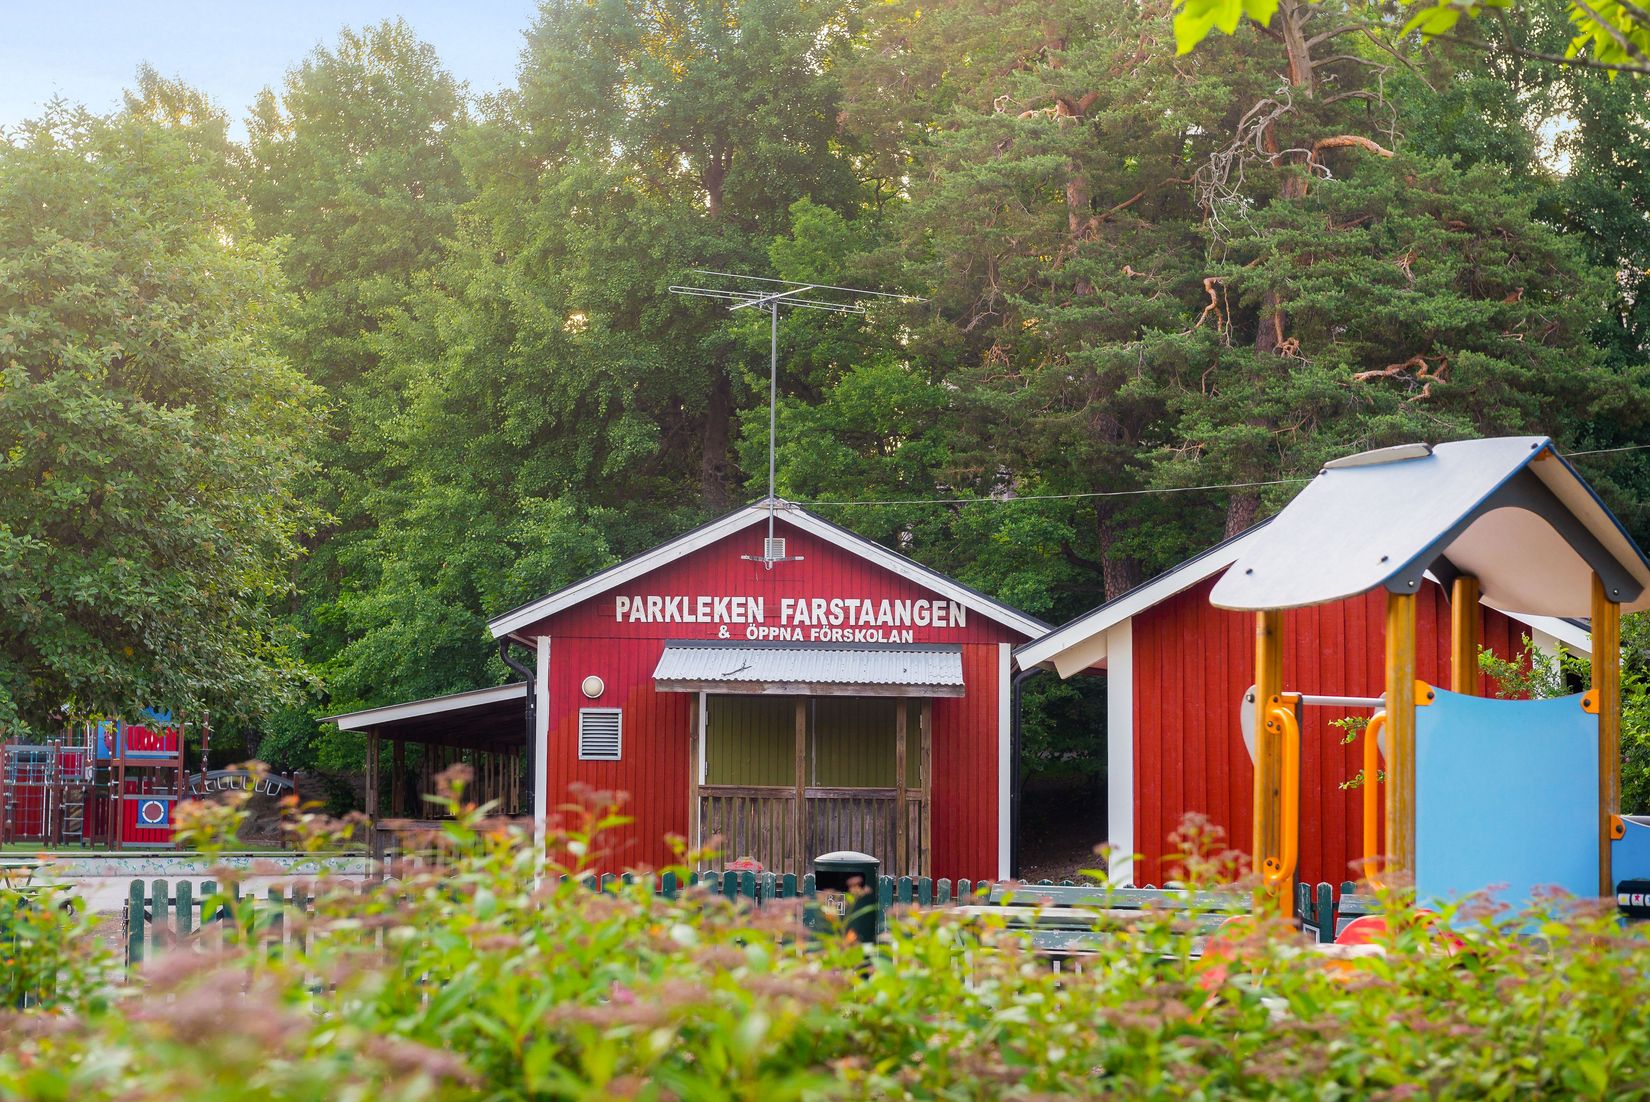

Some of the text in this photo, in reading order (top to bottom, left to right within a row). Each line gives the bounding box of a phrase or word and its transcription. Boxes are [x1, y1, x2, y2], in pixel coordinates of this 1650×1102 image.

[615, 595, 967, 628] PARKLEKEN FARSTAANGEN
[718, 624, 914, 644] & ÖPPNA FÖRSKOLAN
